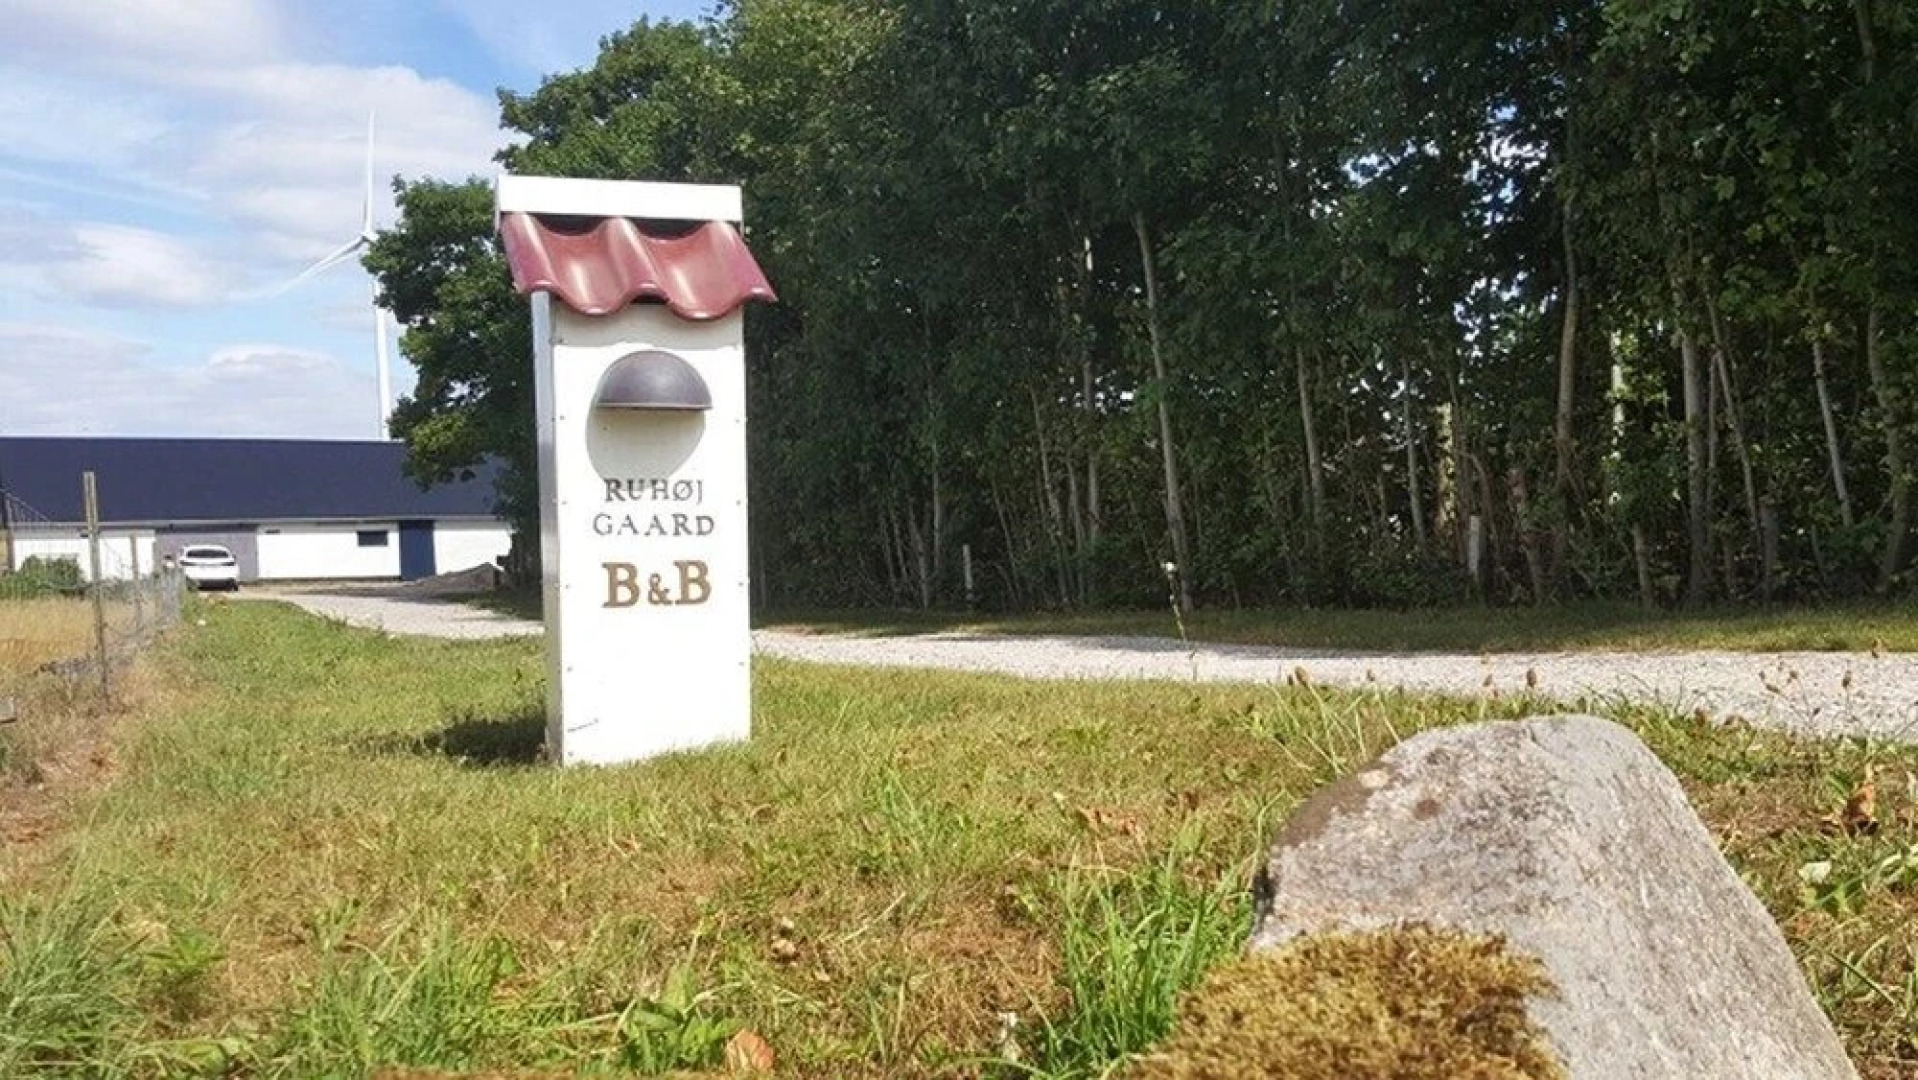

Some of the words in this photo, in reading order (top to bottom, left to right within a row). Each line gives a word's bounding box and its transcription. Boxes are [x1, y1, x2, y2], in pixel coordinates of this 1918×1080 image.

[603, 477, 703, 505] RUHØJ
[592, 512, 715, 536] GAARD
[601, 560, 712, 609] B&B
